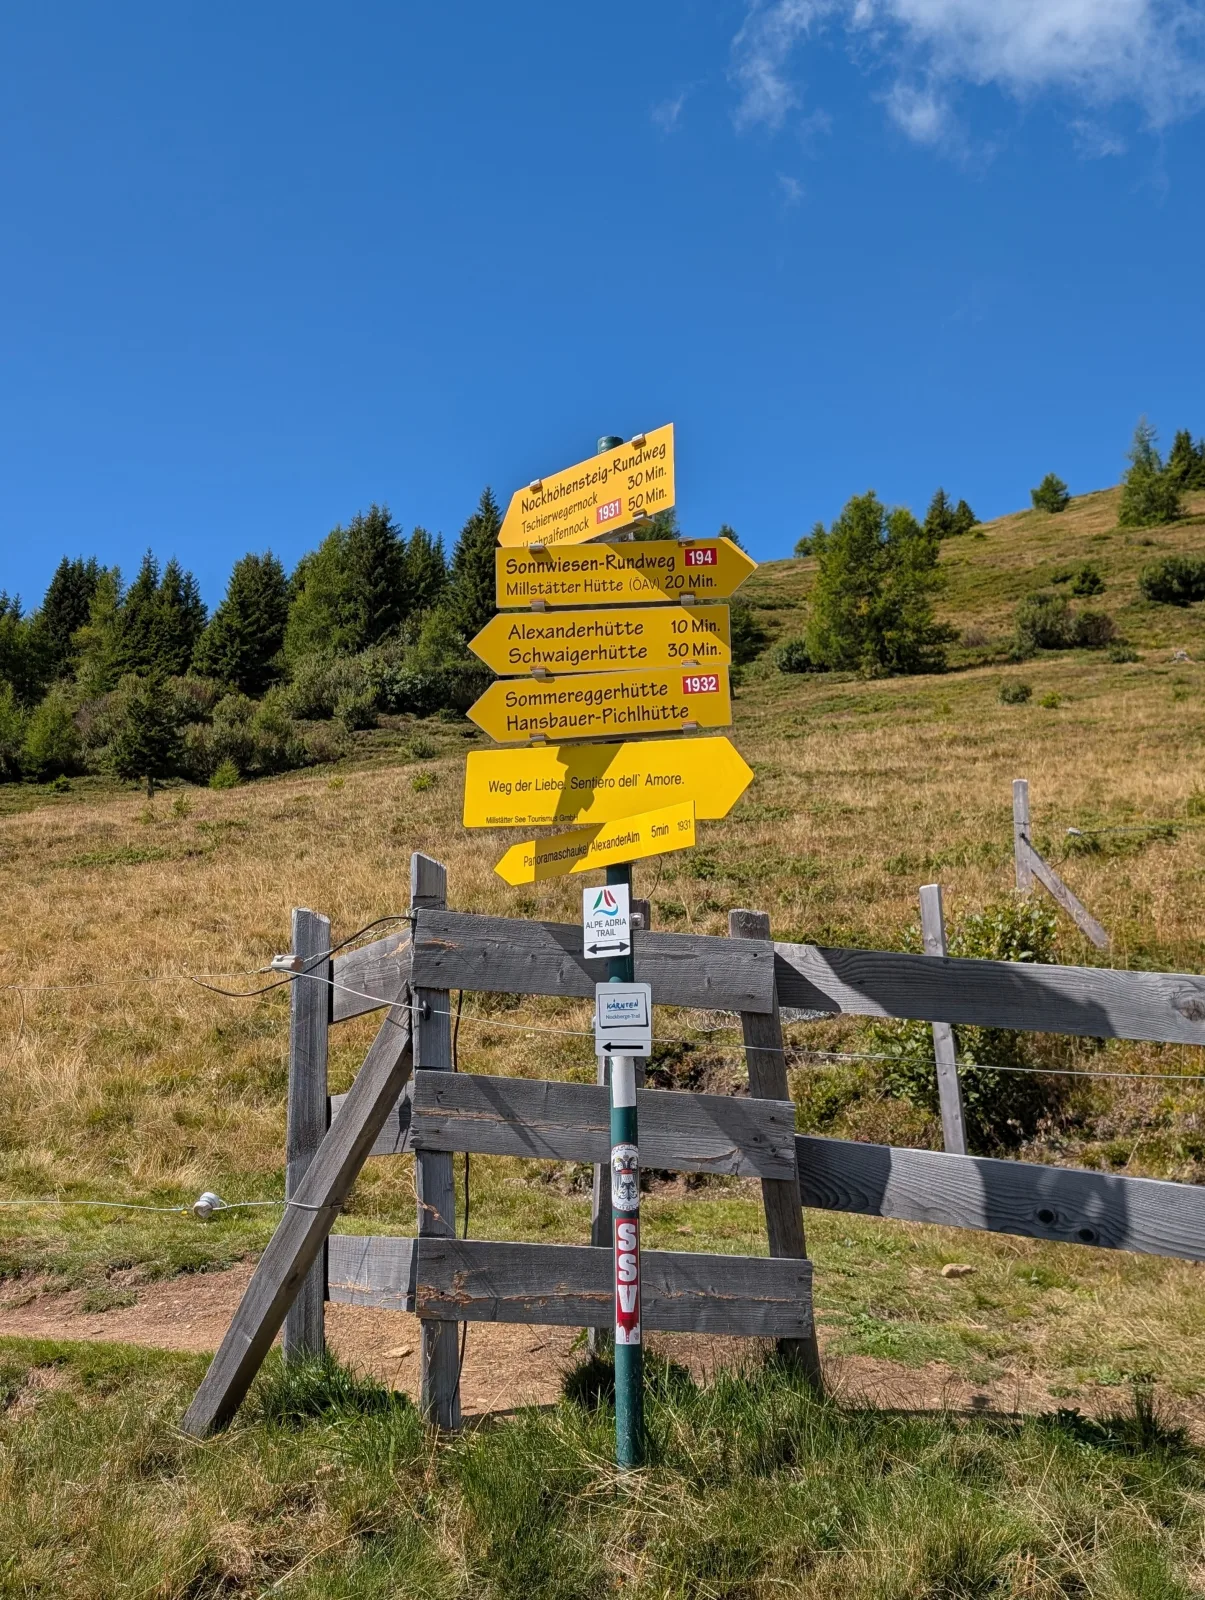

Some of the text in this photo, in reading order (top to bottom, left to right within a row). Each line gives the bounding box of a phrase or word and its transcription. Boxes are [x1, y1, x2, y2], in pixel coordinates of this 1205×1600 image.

[521, 443, 666, 514] Nockhöhensteig-Rundweg
[522, 466, 667, 534] Tschierwegernock 30 Min.
[628, 493, 643, 511] 50
[646, 488, 667, 505] Min.
[598, 501, 620, 521] 1931
[506, 553, 675, 575] Sonnwiesen-Rundweg
[688, 550, 713, 565] 194
[506, 580, 581, 596] Millstätter
[584, 579, 623, 593] Hütte
[664, 575, 685, 589] 20
[688, 574, 717, 588] Min.
[508, 619, 721, 641] Alexanderhütte 10 Min.
[508, 642, 722, 666] Schwaigerhütte 30 Min.
[505, 682, 668, 708] Sommereggerhütte
[685, 676, 717, 692] 1932
[506, 704, 689, 732] Hansbauer-Pichlhütte
[488, 780, 512, 795] Weg
[515, 779, 532, 792] der
[570, 776, 615, 790] Sentiero
[644, 773, 685, 786] Amore.
[528, 815, 557, 823] Tourismus
[523, 820, 691, 868] Panoramaschaukel AlexanderAlm 5min 1931
[586, 918, 627, 929] ALPE ADRIA
[596, 929, 617, 938] TRAIL
[617, 1222, 638, 1313] SSV
